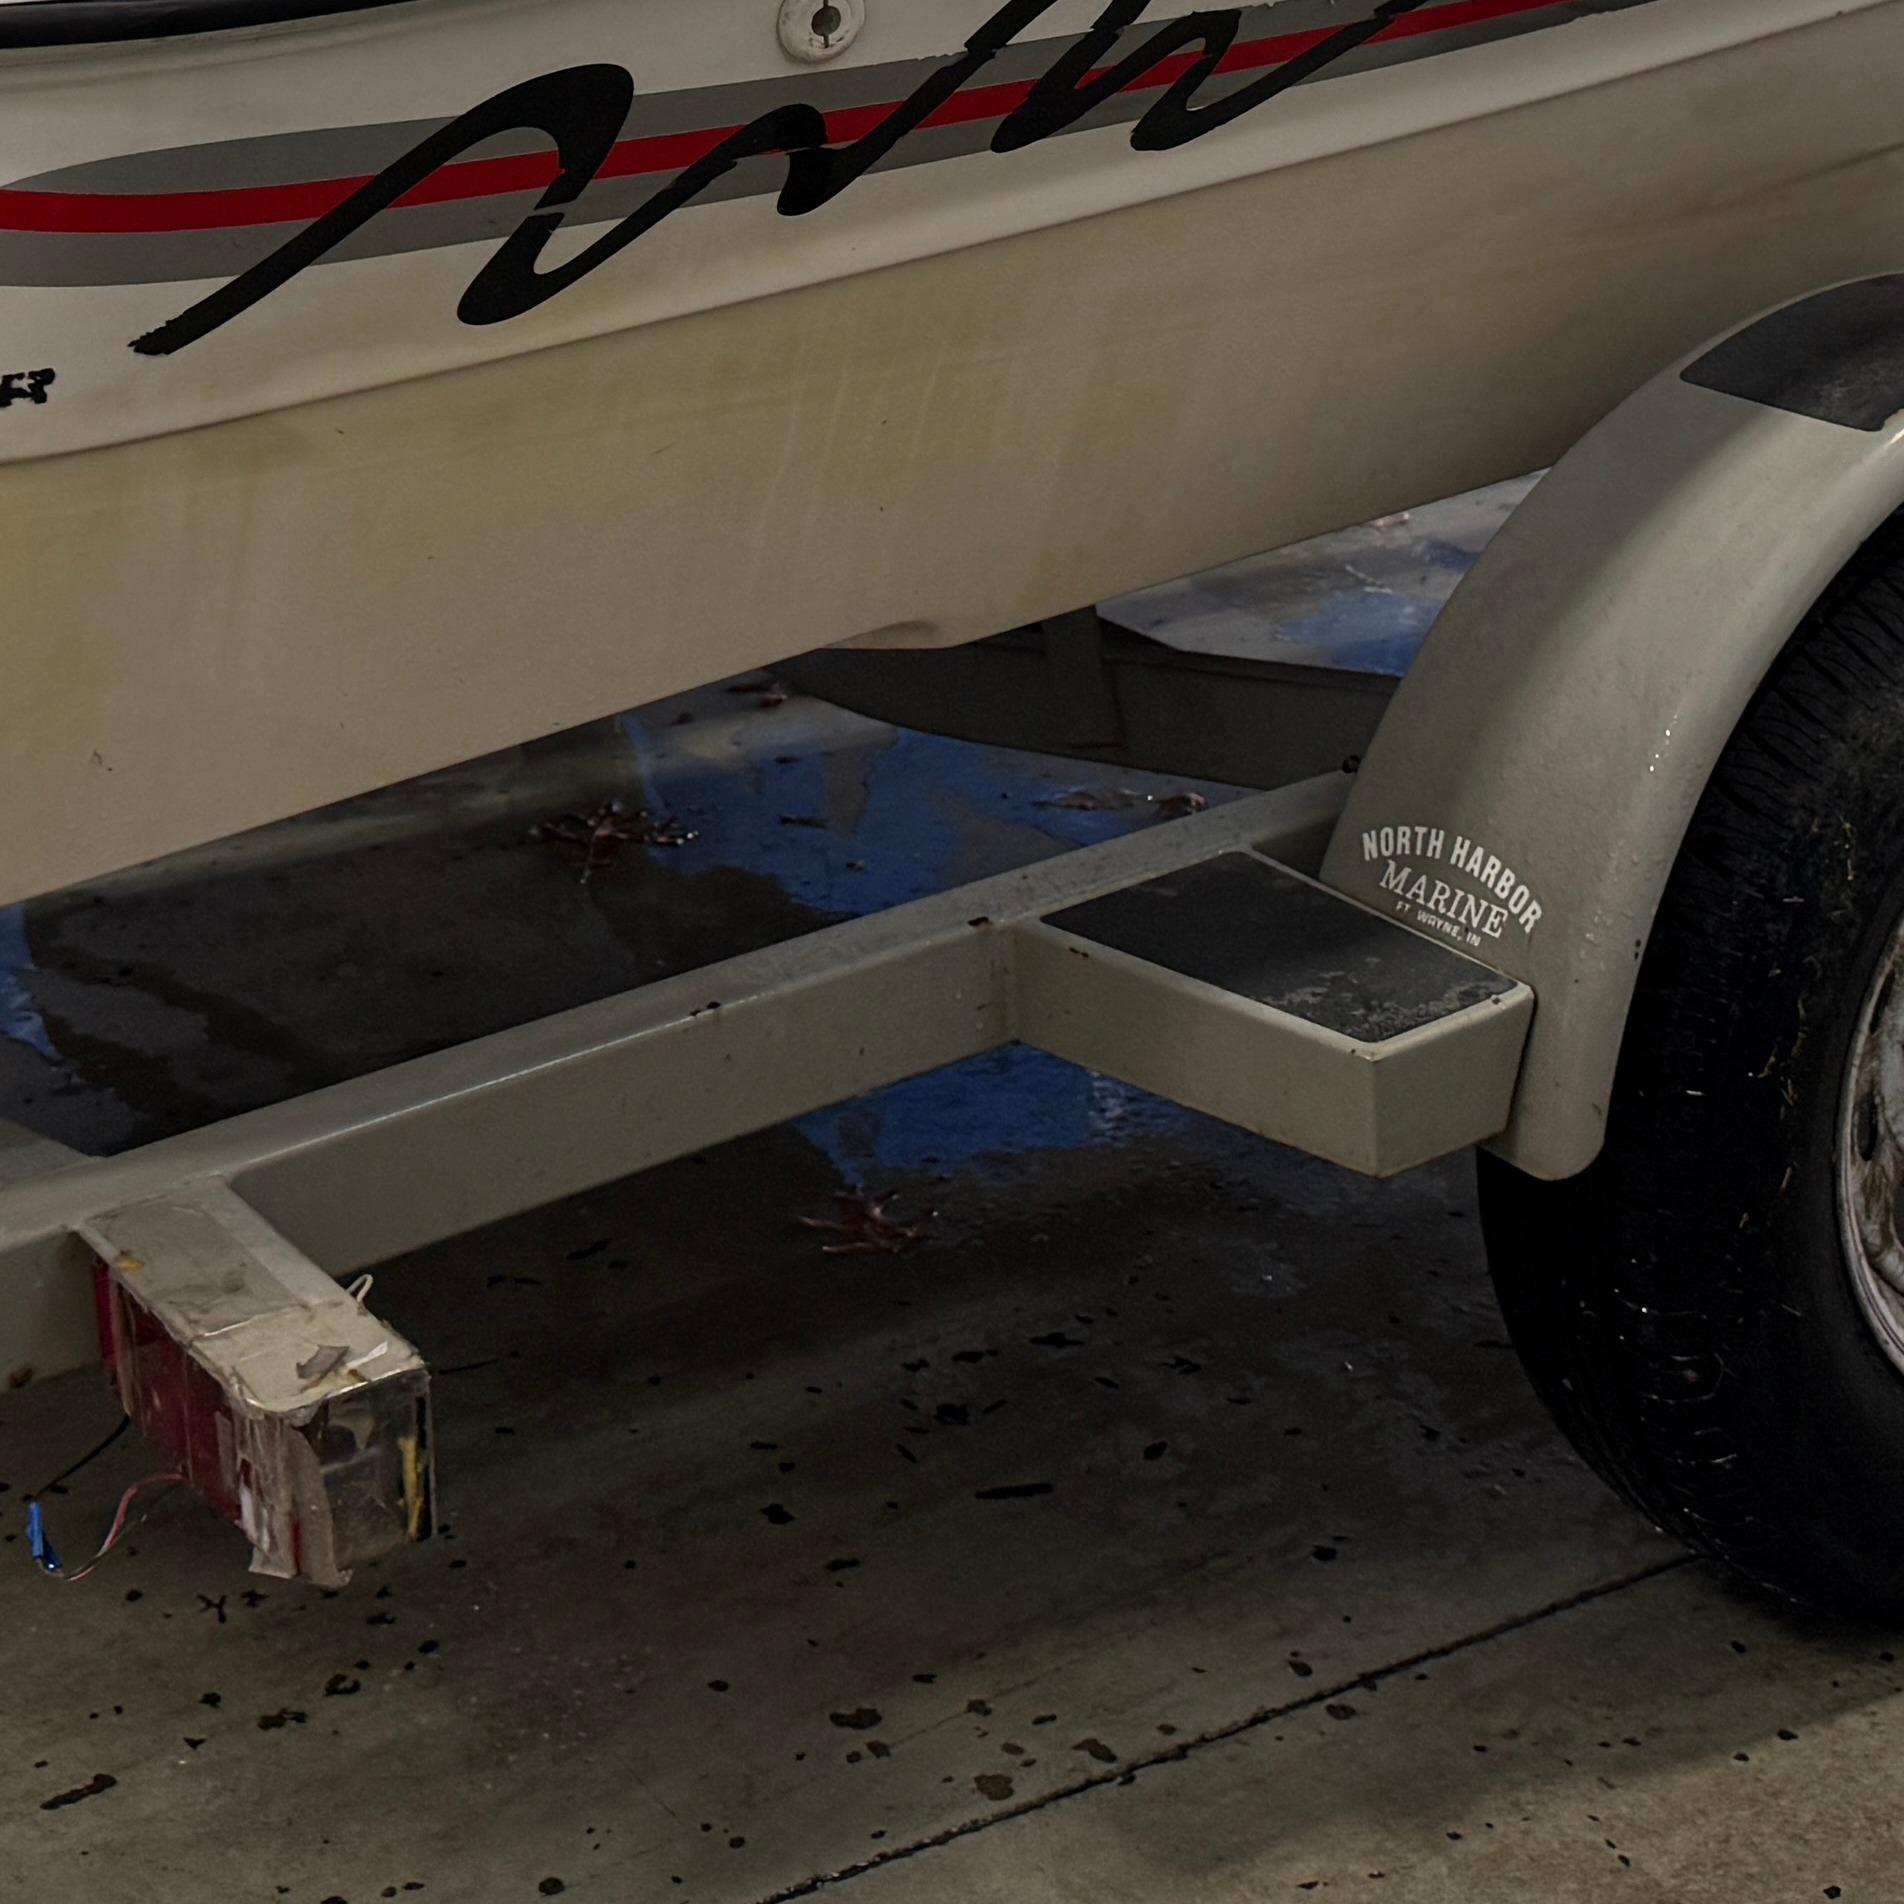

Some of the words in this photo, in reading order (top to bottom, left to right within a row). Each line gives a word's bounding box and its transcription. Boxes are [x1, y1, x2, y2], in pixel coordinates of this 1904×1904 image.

[1362, 826, 1445, 861] NORTH
[1450, 836, 1542, 934] HARBOR
[1379, 859, 1509, 939] MARINE
